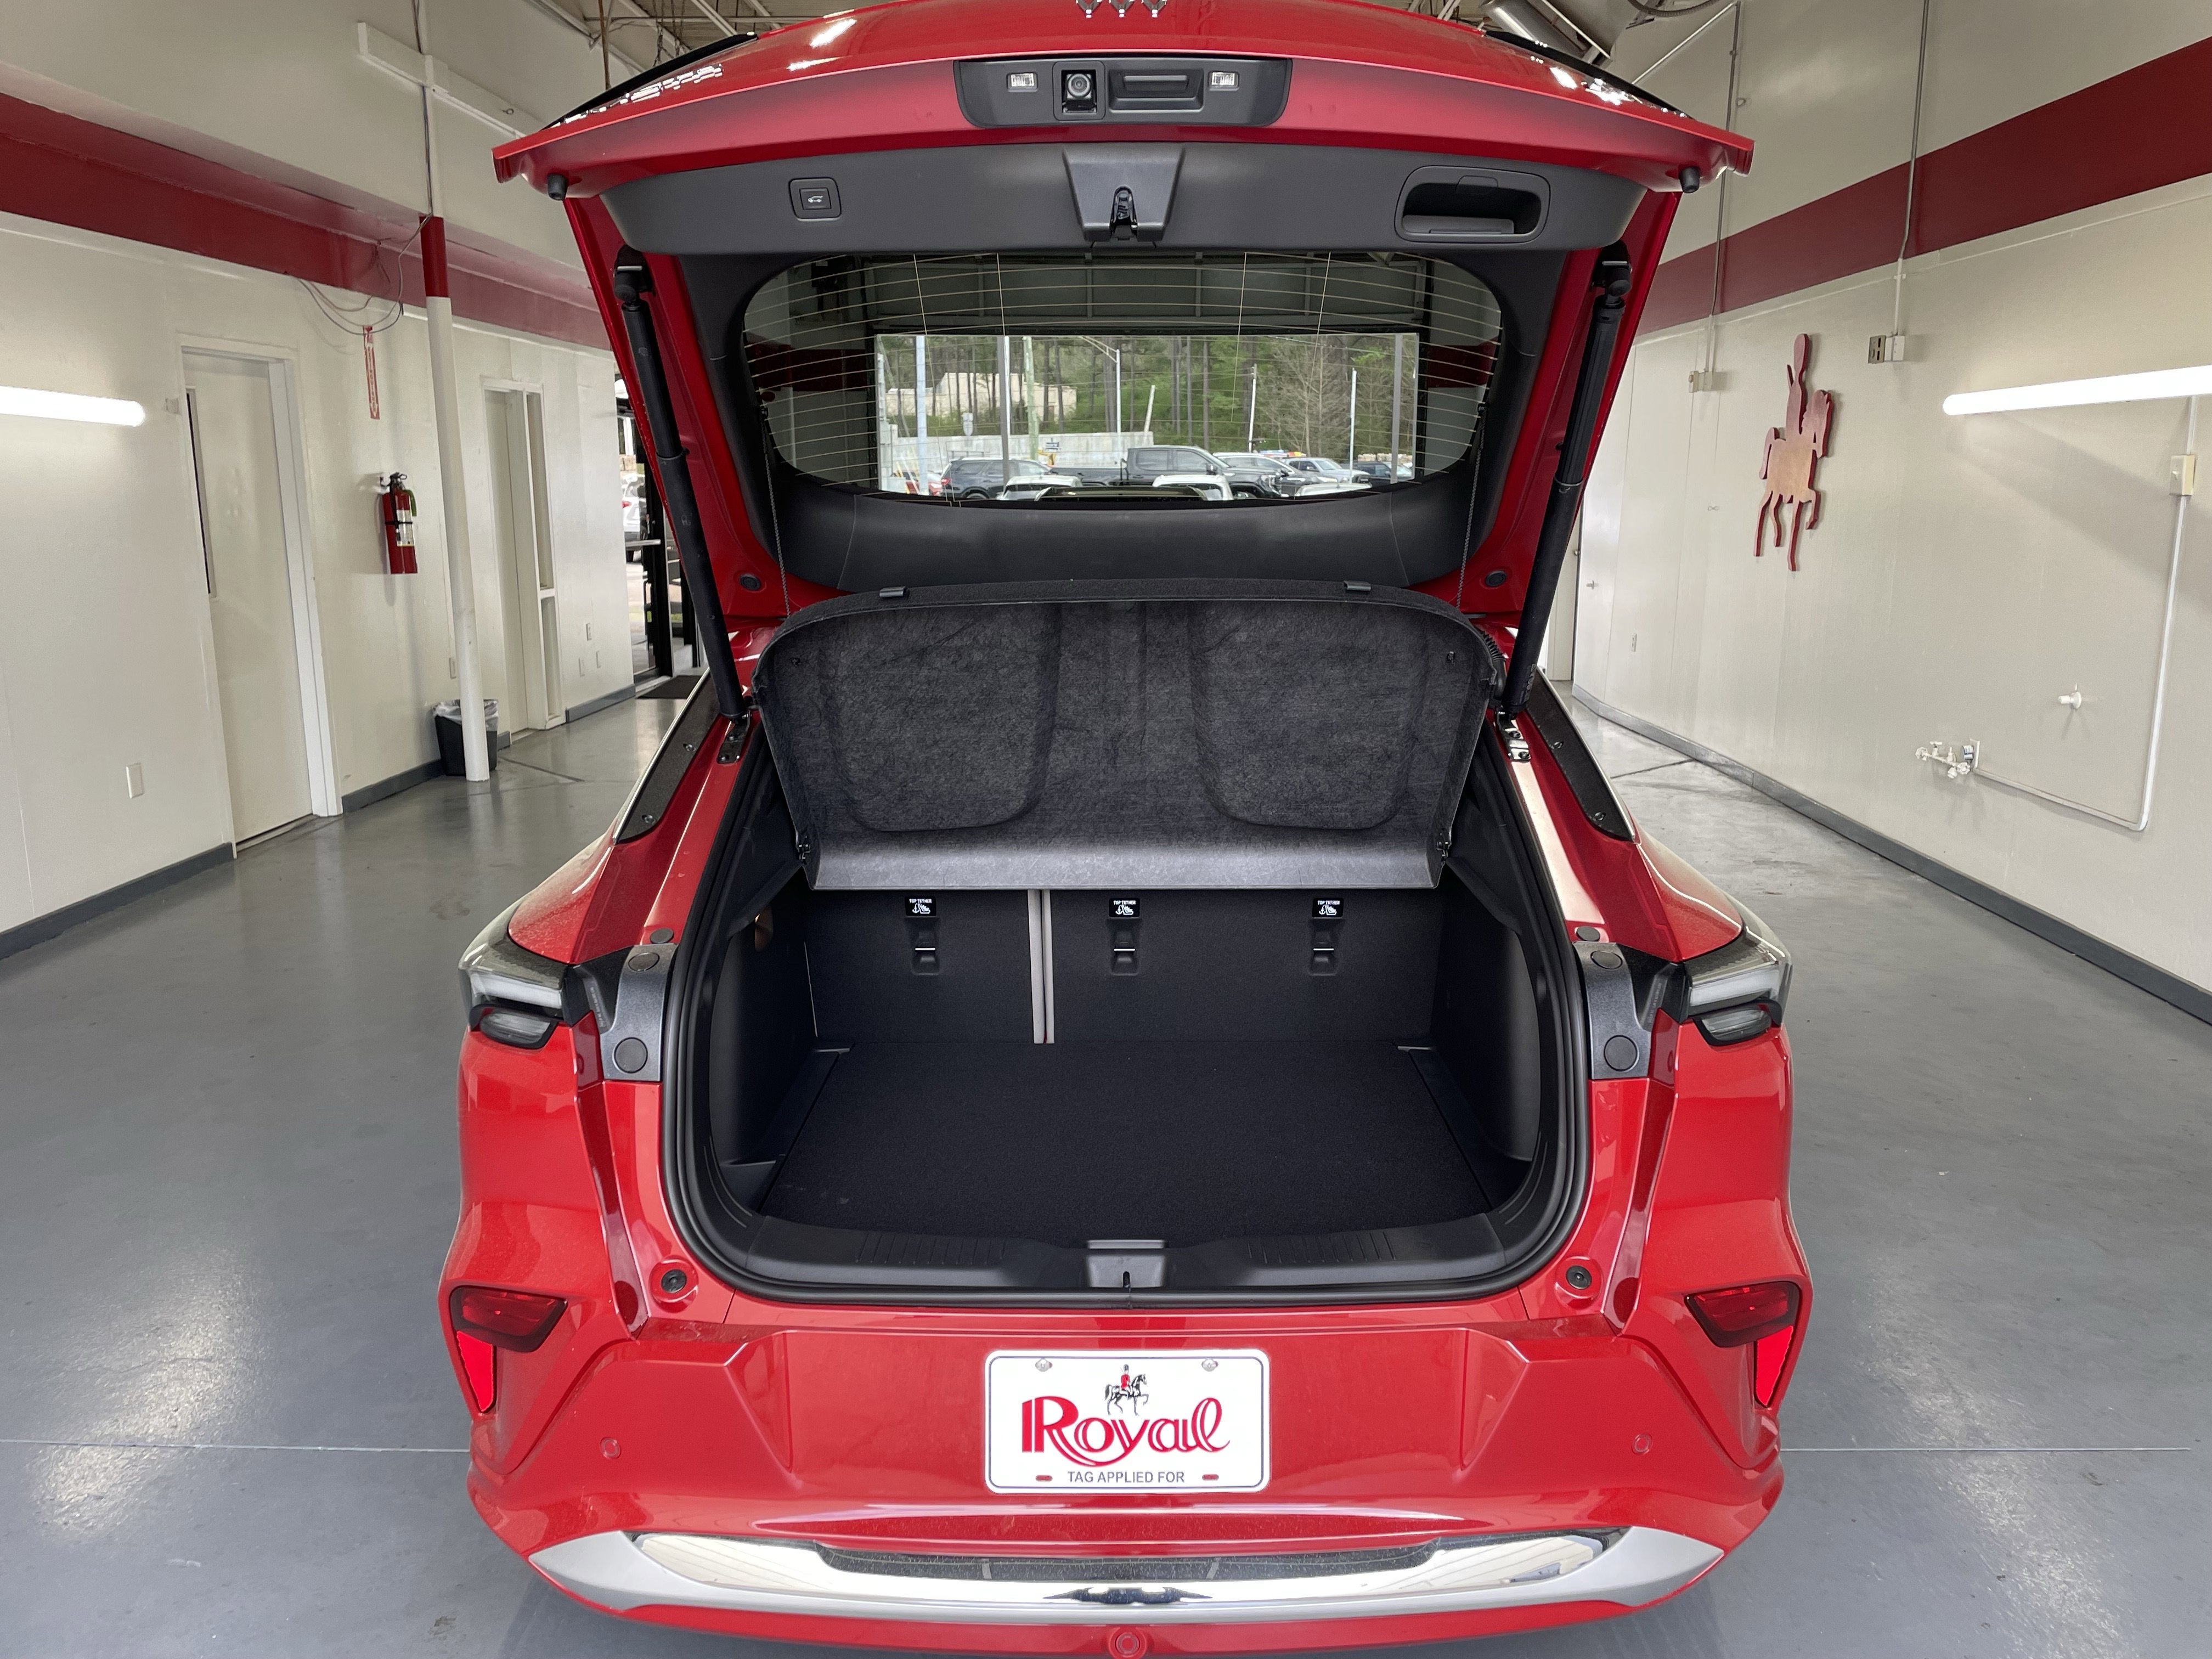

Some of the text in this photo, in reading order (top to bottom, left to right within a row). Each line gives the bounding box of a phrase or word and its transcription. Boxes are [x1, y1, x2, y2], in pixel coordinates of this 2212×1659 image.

[1022, 1395, 1231, 1468] Royal
[1067, 1471, 1185, 1483] TAG APPLIED FOR
